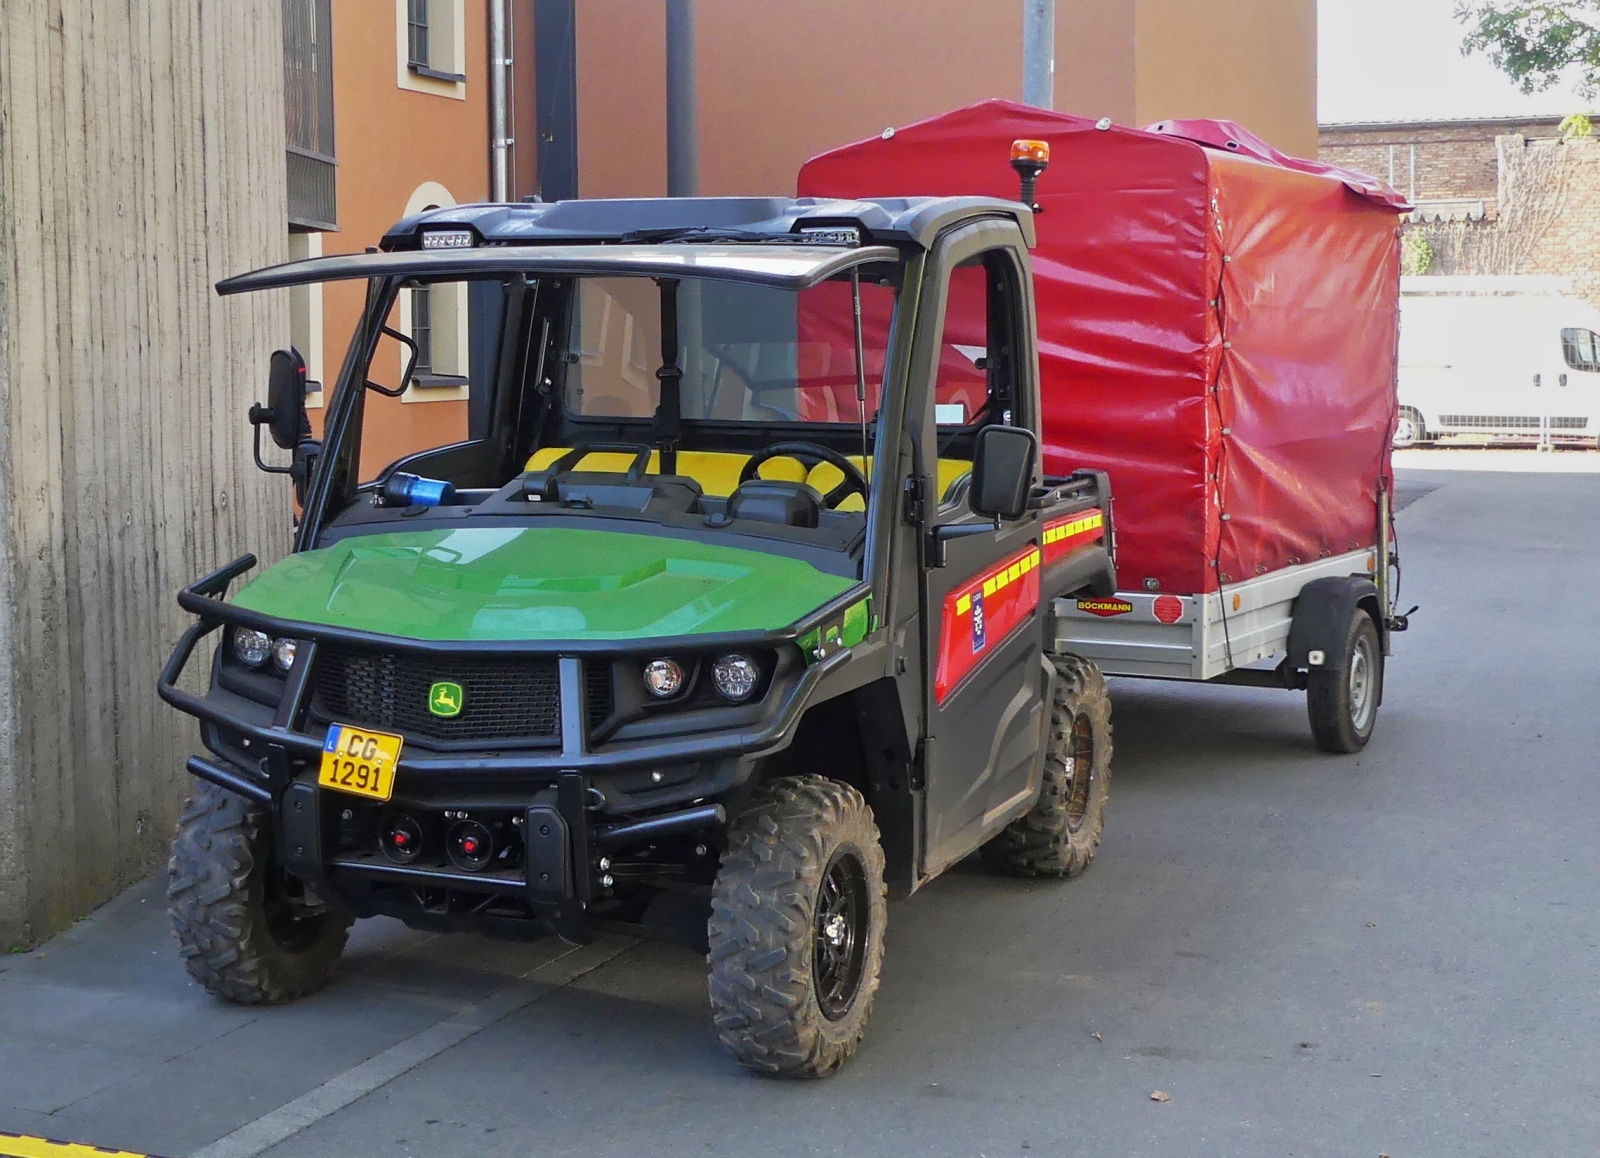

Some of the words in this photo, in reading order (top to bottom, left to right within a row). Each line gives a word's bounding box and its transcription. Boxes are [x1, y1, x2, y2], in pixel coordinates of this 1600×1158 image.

[327, 740, 333, 750] L
[346, 734, 378, 761] CG
[329, 758, 381, 792] 1291
